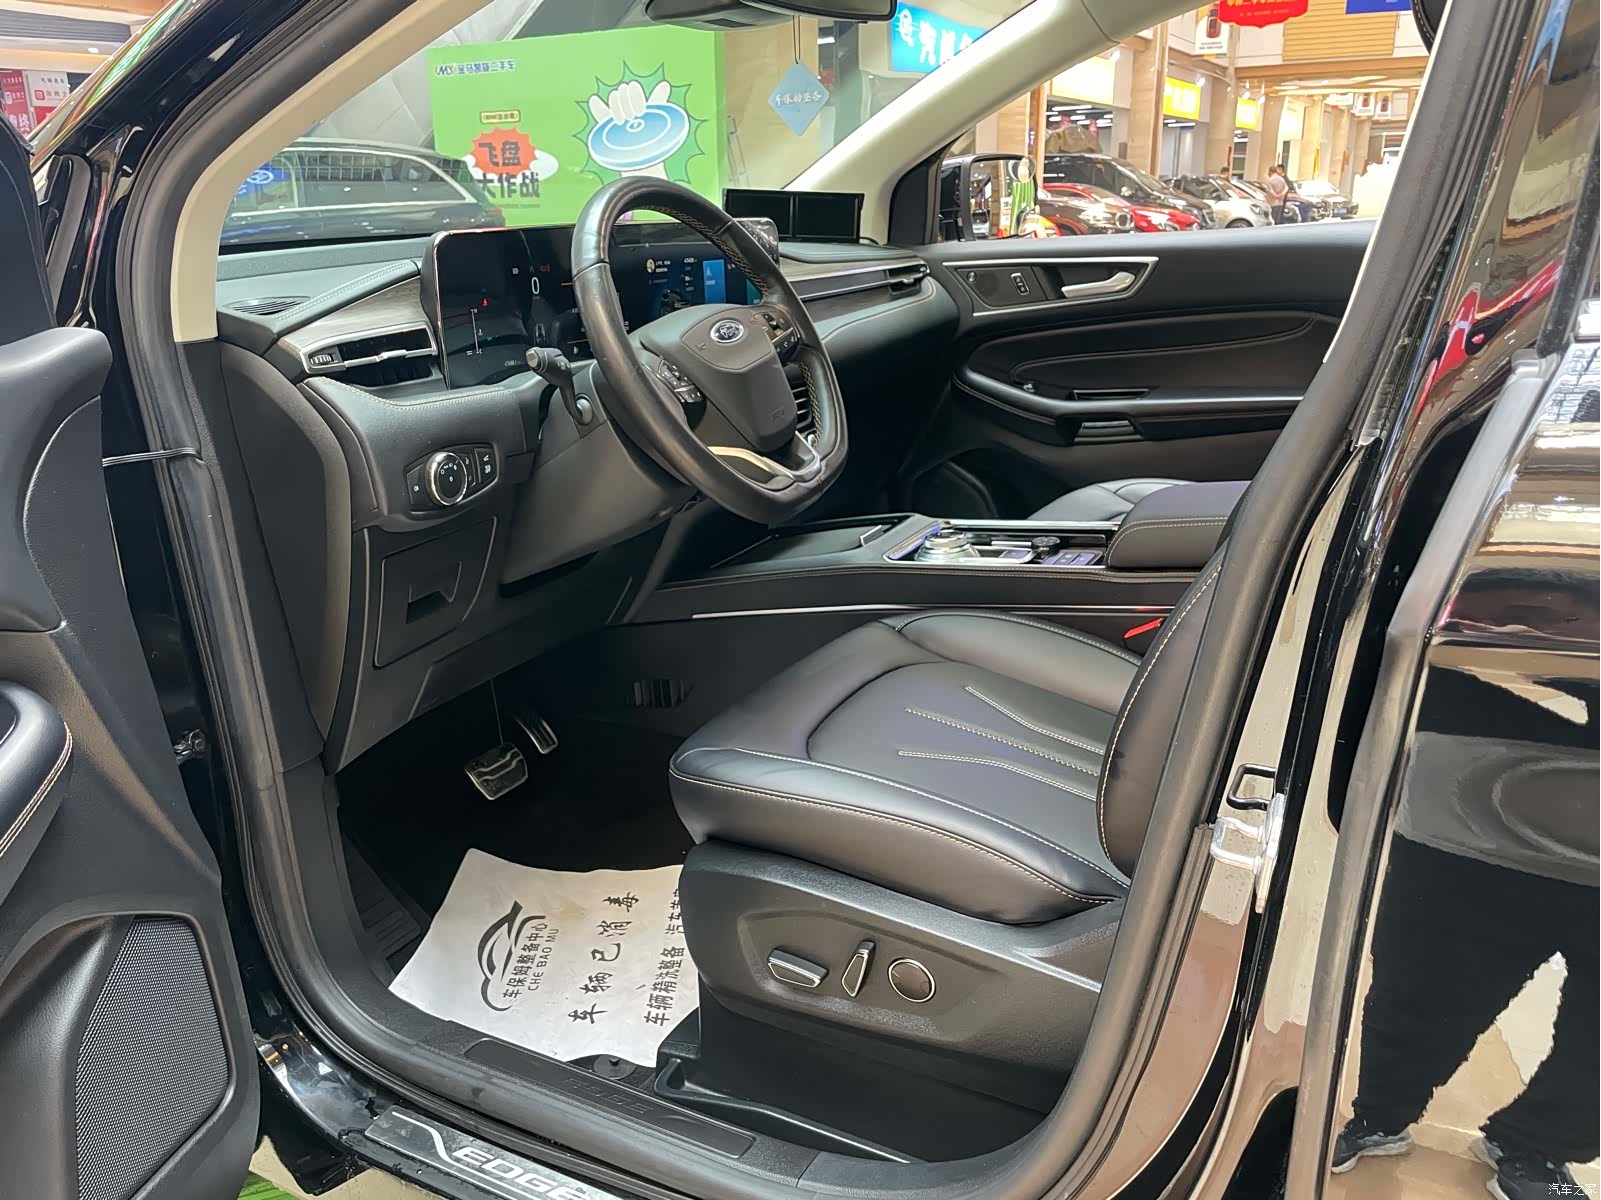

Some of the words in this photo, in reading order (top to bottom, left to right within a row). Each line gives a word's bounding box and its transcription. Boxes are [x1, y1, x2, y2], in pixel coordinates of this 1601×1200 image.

[476, 172, 540, 198] 大作战
[478, 140, 521, 167] 飞盘
[502, 923, 548, 998] 车保姆整备中心
[528, 972, 544, 991] CHE
[536, 947, 552, 968] BAO
[545, 928, 559, 943] MU
[568, 892, 639, 1025] 车辆已消毒
[643, 946, 685, 1027] 车辆精洗整备
